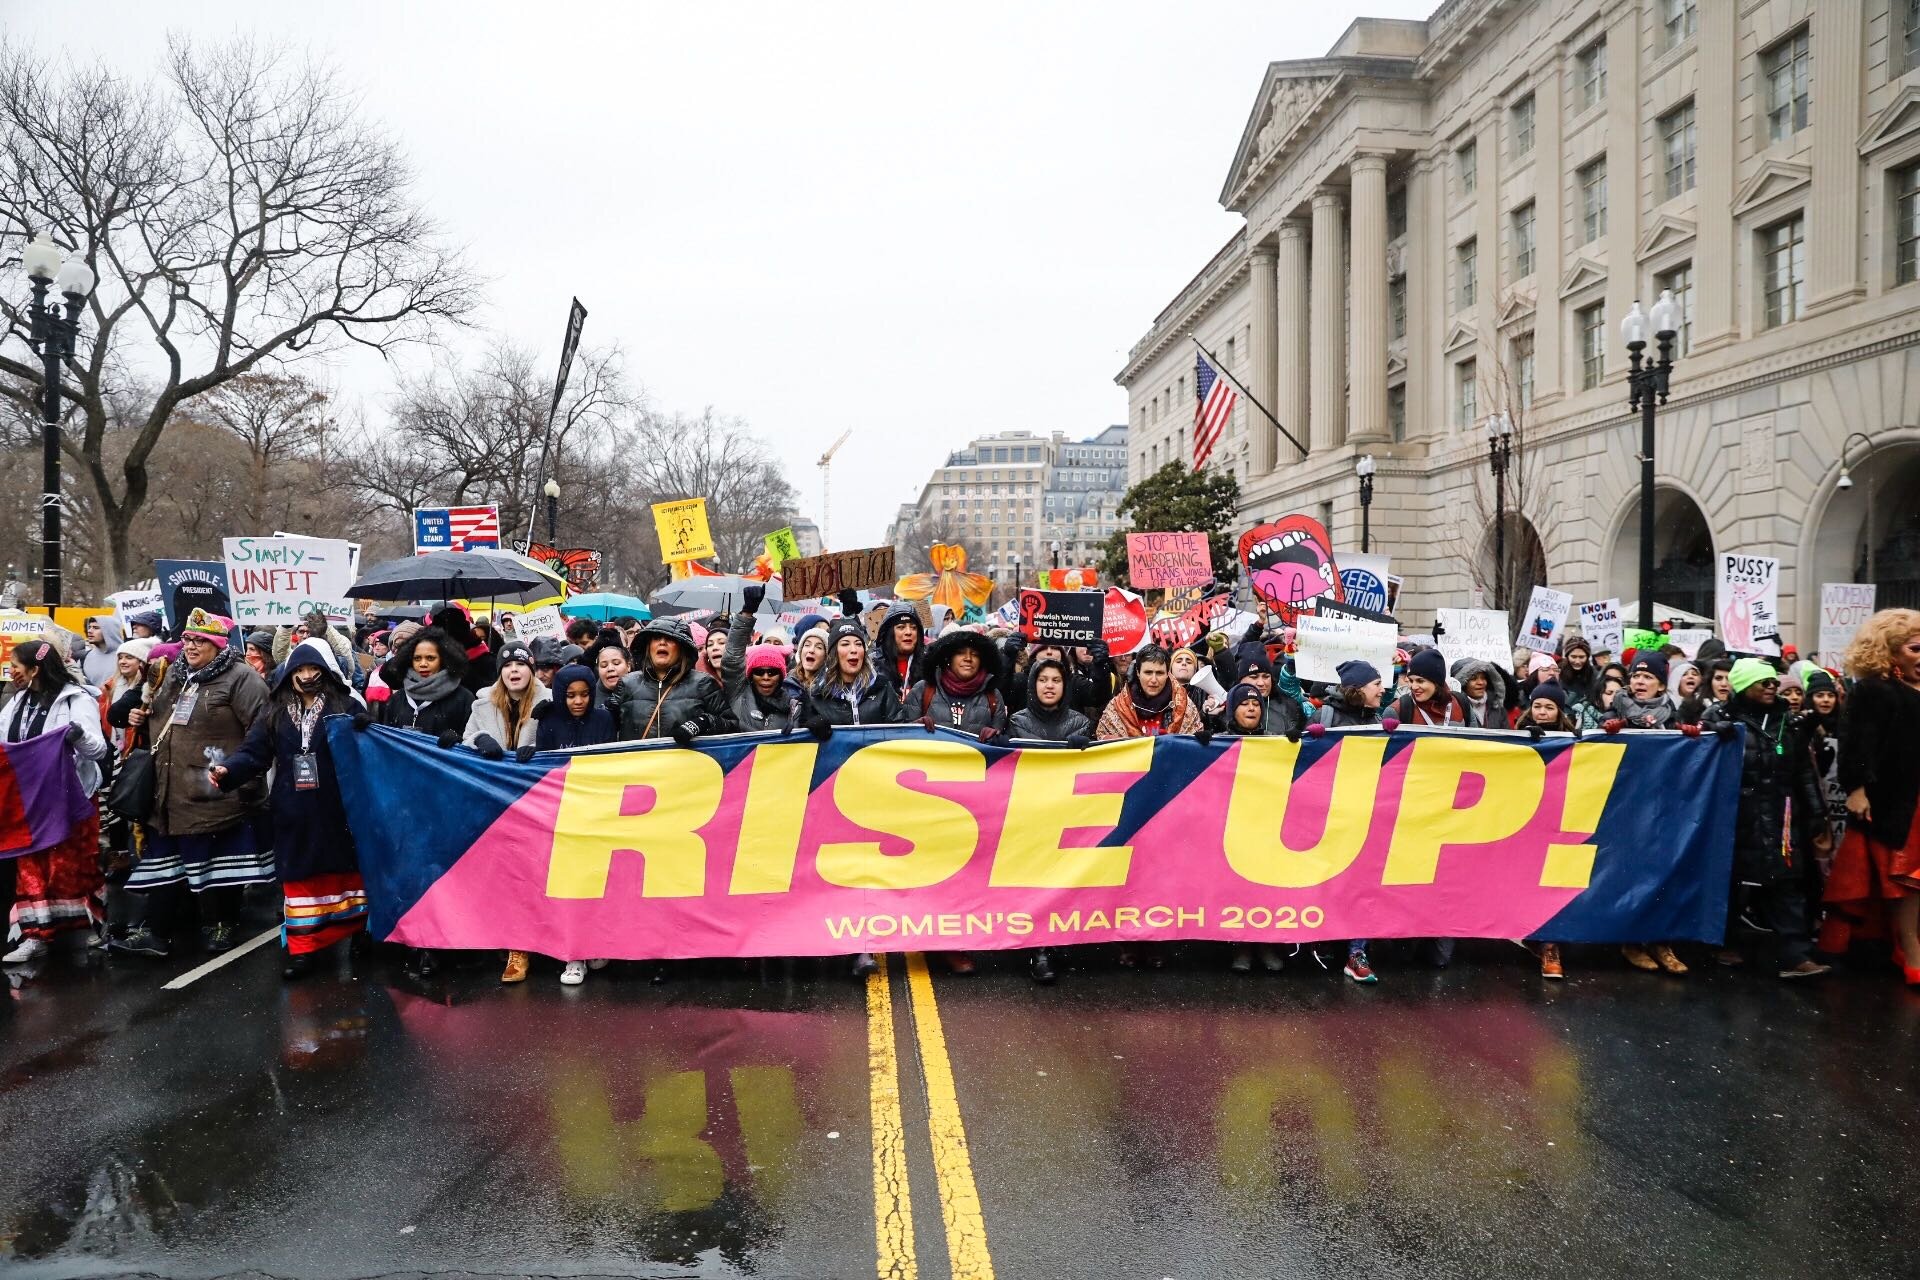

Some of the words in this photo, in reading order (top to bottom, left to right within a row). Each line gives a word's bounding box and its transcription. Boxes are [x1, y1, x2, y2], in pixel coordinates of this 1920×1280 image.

[422, 518, 444, 526] UNITED
[423, 535, 443, 543] STAND
[1135, 535, 1168, 552] STOP
[1170, 534, 1199, 551] THE
[1727, 557, 1774, 578] PUSSY
[169, 569, 220, 587] SHITHOLE
[1134, 569, 1144, 578] OF
[1149, 568, 1180, 580] TRANS
[1182, 568, 1211, 577] WOMEN
[1727, 575, 1764, 585] POWER
[232, 568, 318, 595] UNFIT
[1153, 580, 1168, 588] OF
[1169, 577, 1200, 587] COLOR
[182, 586, 213, 595] PRESIDENT
[236, 599, 260, 619] For
[1581, 602, 1607, 615] KNOW
[1752, 601, 1764, 611] TO
[518, 614, 551, 627] Women
[1033, 613, 1060, 622] Jewish
[1591, 611, 1617, 623] YOUR
[2, 621, 45, 632] WOMEN
[1033, 620, 1058, 628] march
[1753, 624, 1777, 636] POLLS
[1033, 628, 1095, 640] JUSTICE
[545, 736, 1153, 898] RISE
[1222, 736, 1627, 888] UP!
[825, 912, 1034, 939] WOMEN'S
[1048, 906, 1205, 933] MARCH
[1220, 905, 1326, 929] 2020
